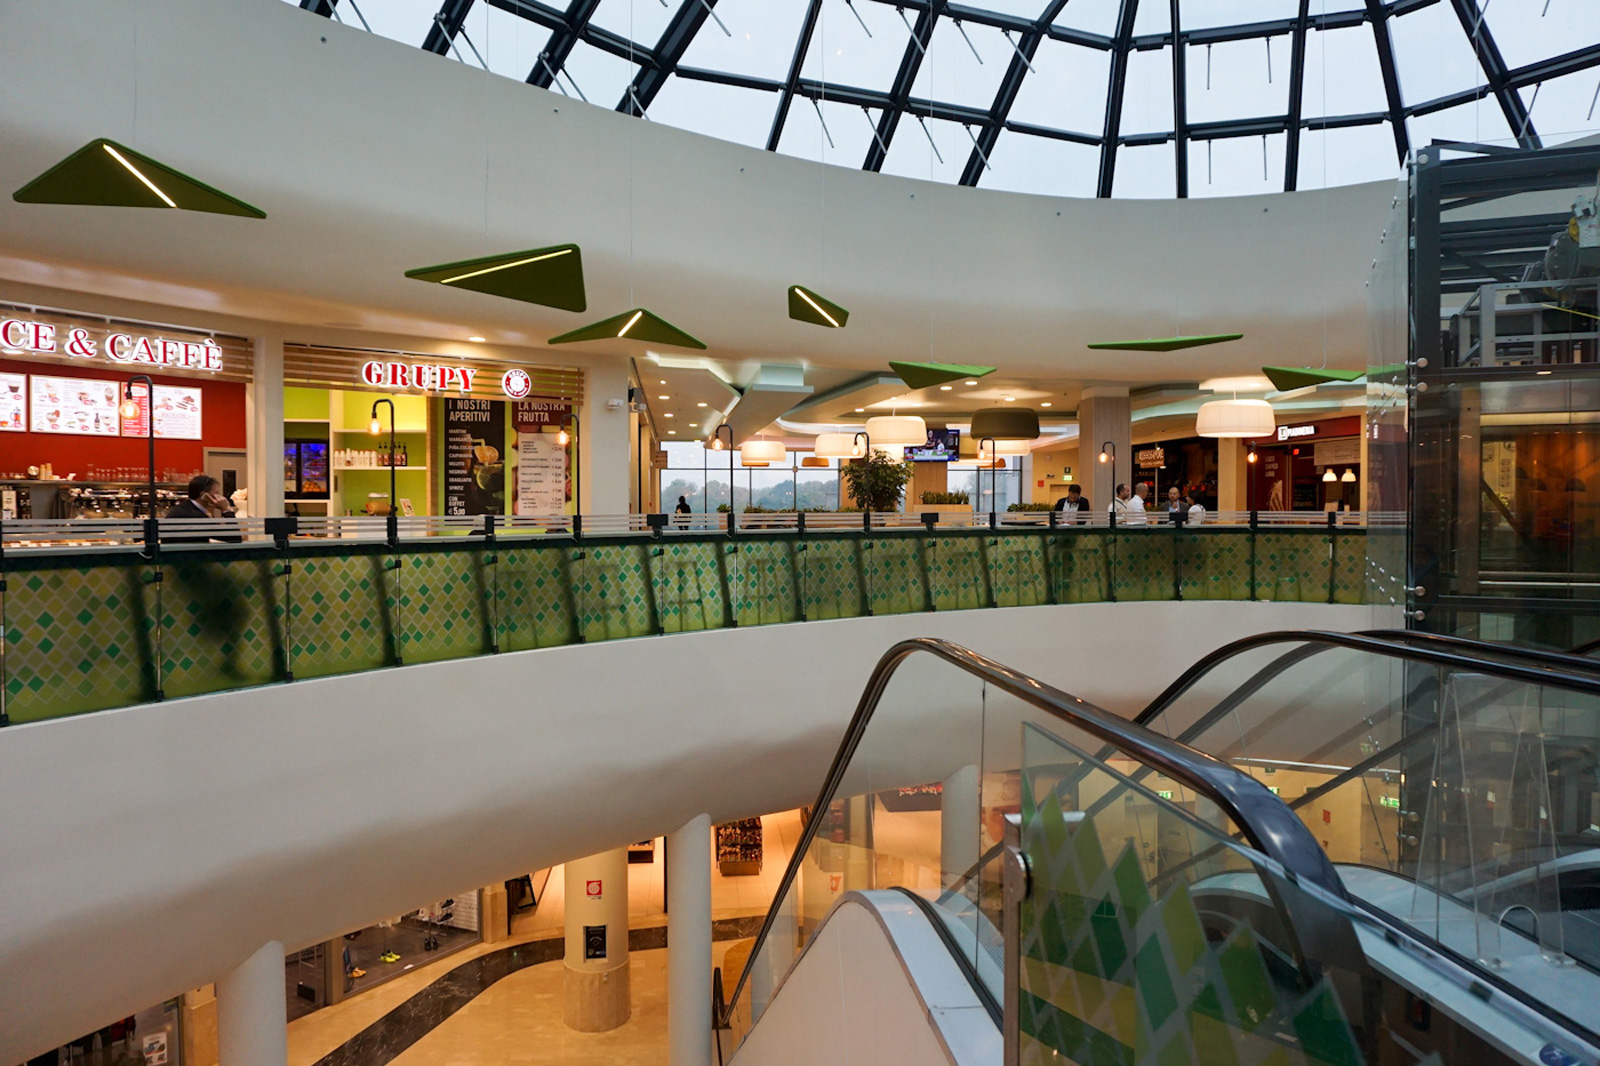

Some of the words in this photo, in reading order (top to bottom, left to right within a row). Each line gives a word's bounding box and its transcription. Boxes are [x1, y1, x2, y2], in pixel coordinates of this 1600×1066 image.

[64, 328, 97, 358] &
[105, 334, 223, 370] CAFFÈ
[362, 361, 477, 391] GRUPY
[448, 399, 452, 410] I
[457, 400, 490, 410] NOSTRI
[518, 401, 530, 411] LA
[449, 411, 490, 422] APERITIVI
[518, 411, 550, 422] FRUTTA
